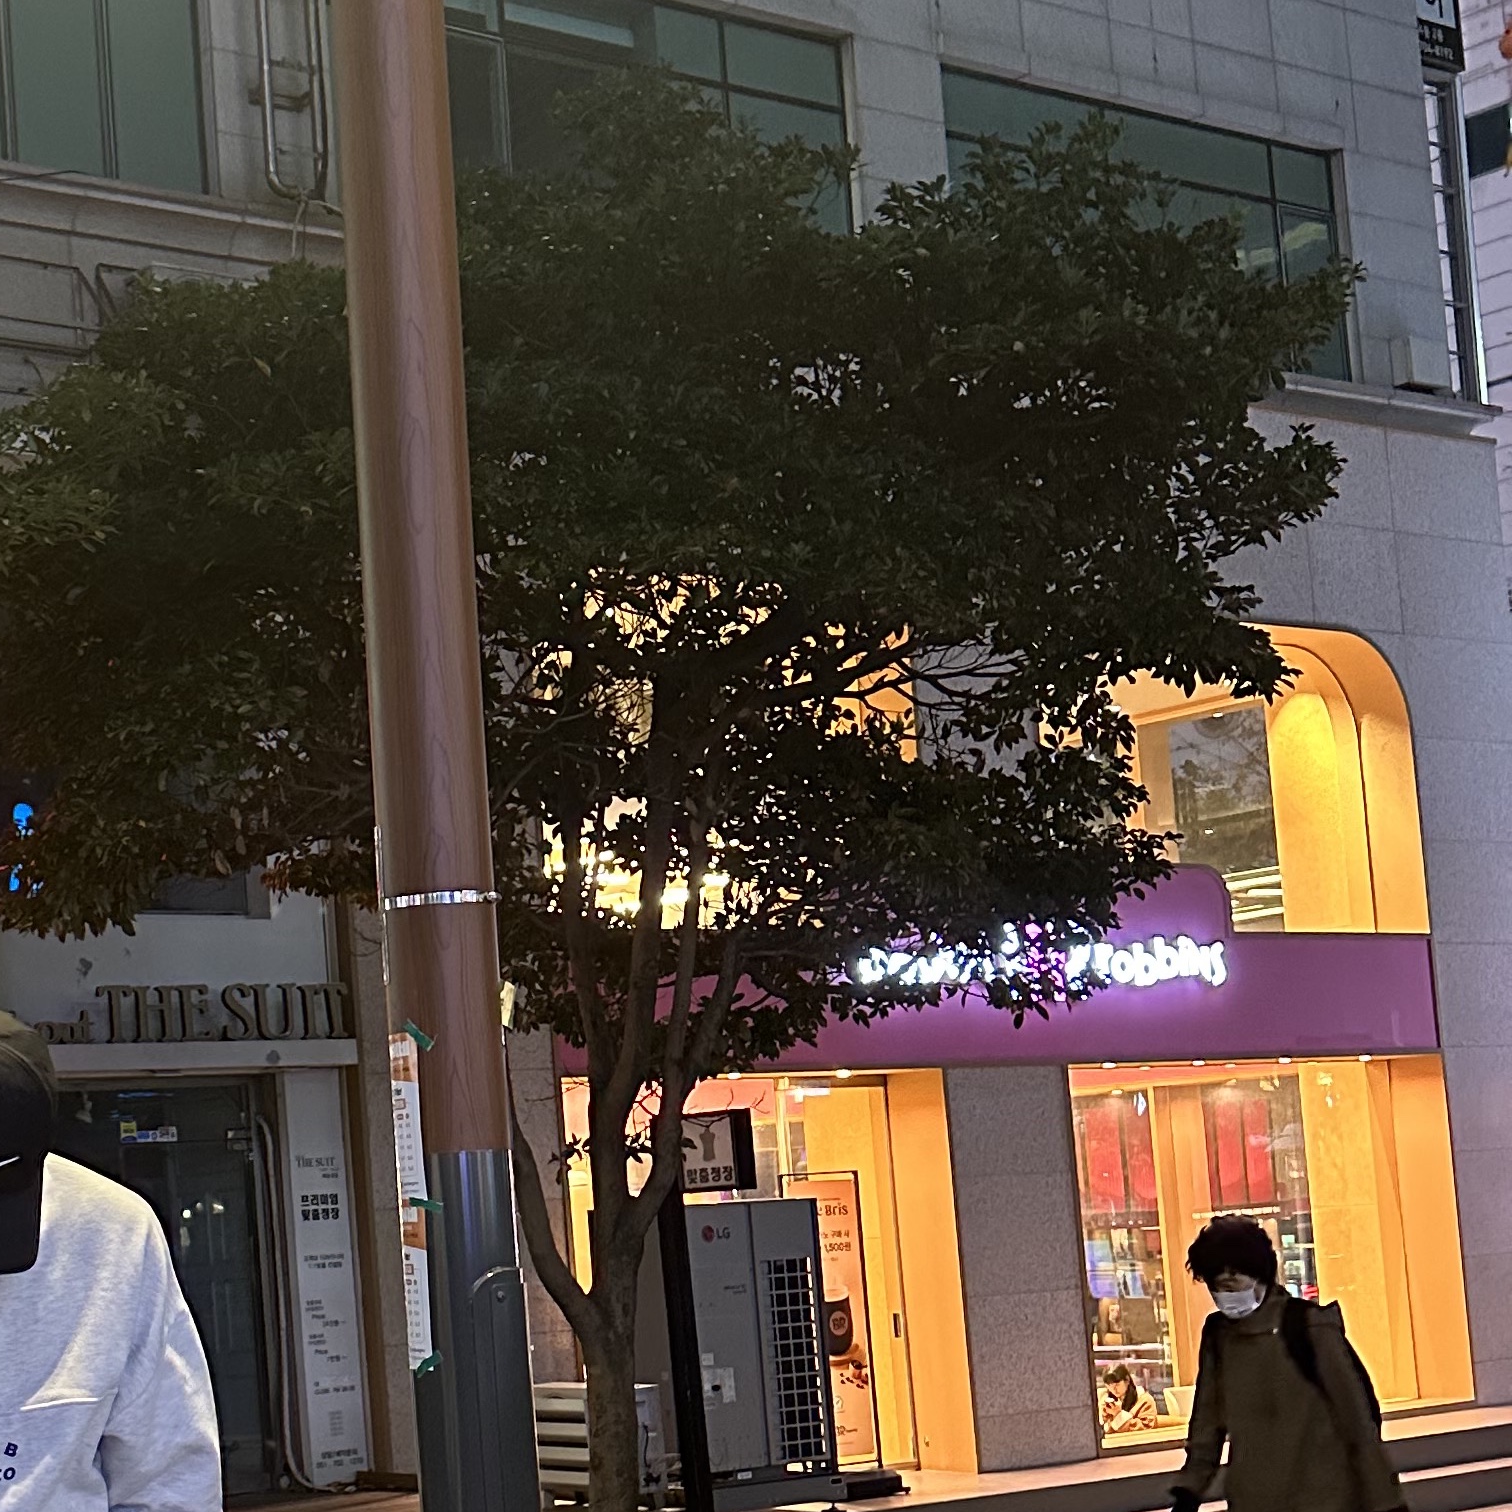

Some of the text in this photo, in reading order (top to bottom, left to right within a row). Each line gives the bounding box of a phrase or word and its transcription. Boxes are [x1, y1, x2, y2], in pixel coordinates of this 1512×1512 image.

[95, 983, 210, 1042] THE
[219, 981, 352, 1041] SUIT
[315, 1156, 336, 1167] SUIT
[686, 1165, 733, 1184] 맞춤정장
[300, 1193, 338, 1207] 프리미엄
[301, 1207, 340, 1221] 맞춤정장
[716, 1226, 731, 1239] LG
